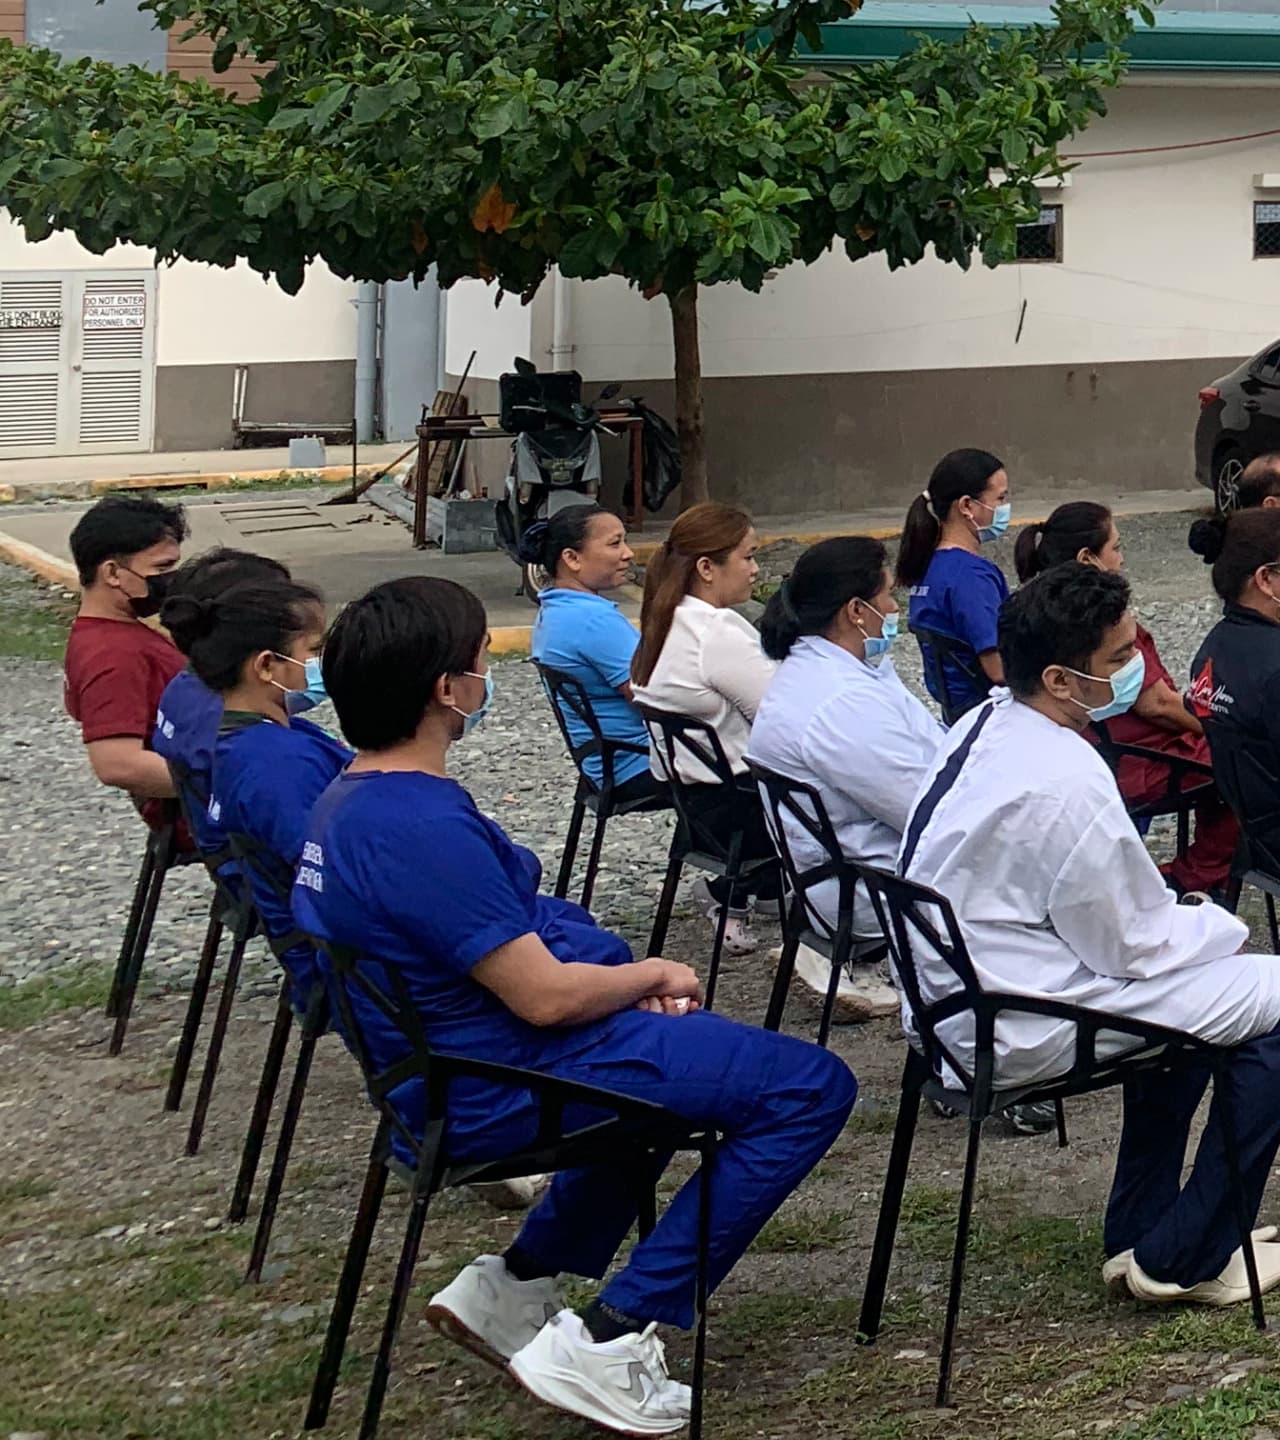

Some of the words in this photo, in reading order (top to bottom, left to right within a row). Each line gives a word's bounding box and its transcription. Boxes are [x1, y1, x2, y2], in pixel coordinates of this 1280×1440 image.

[84, 297, 96, 305] DO
[98, 296, 115, 305] NOT
[118, 296, 144, 304] ENTER
[100, 307, 145, 316] AUTHORIZED
[84, 319, 124, 327] PERSONNEL
[126, 318, 143, 326] ONLY
